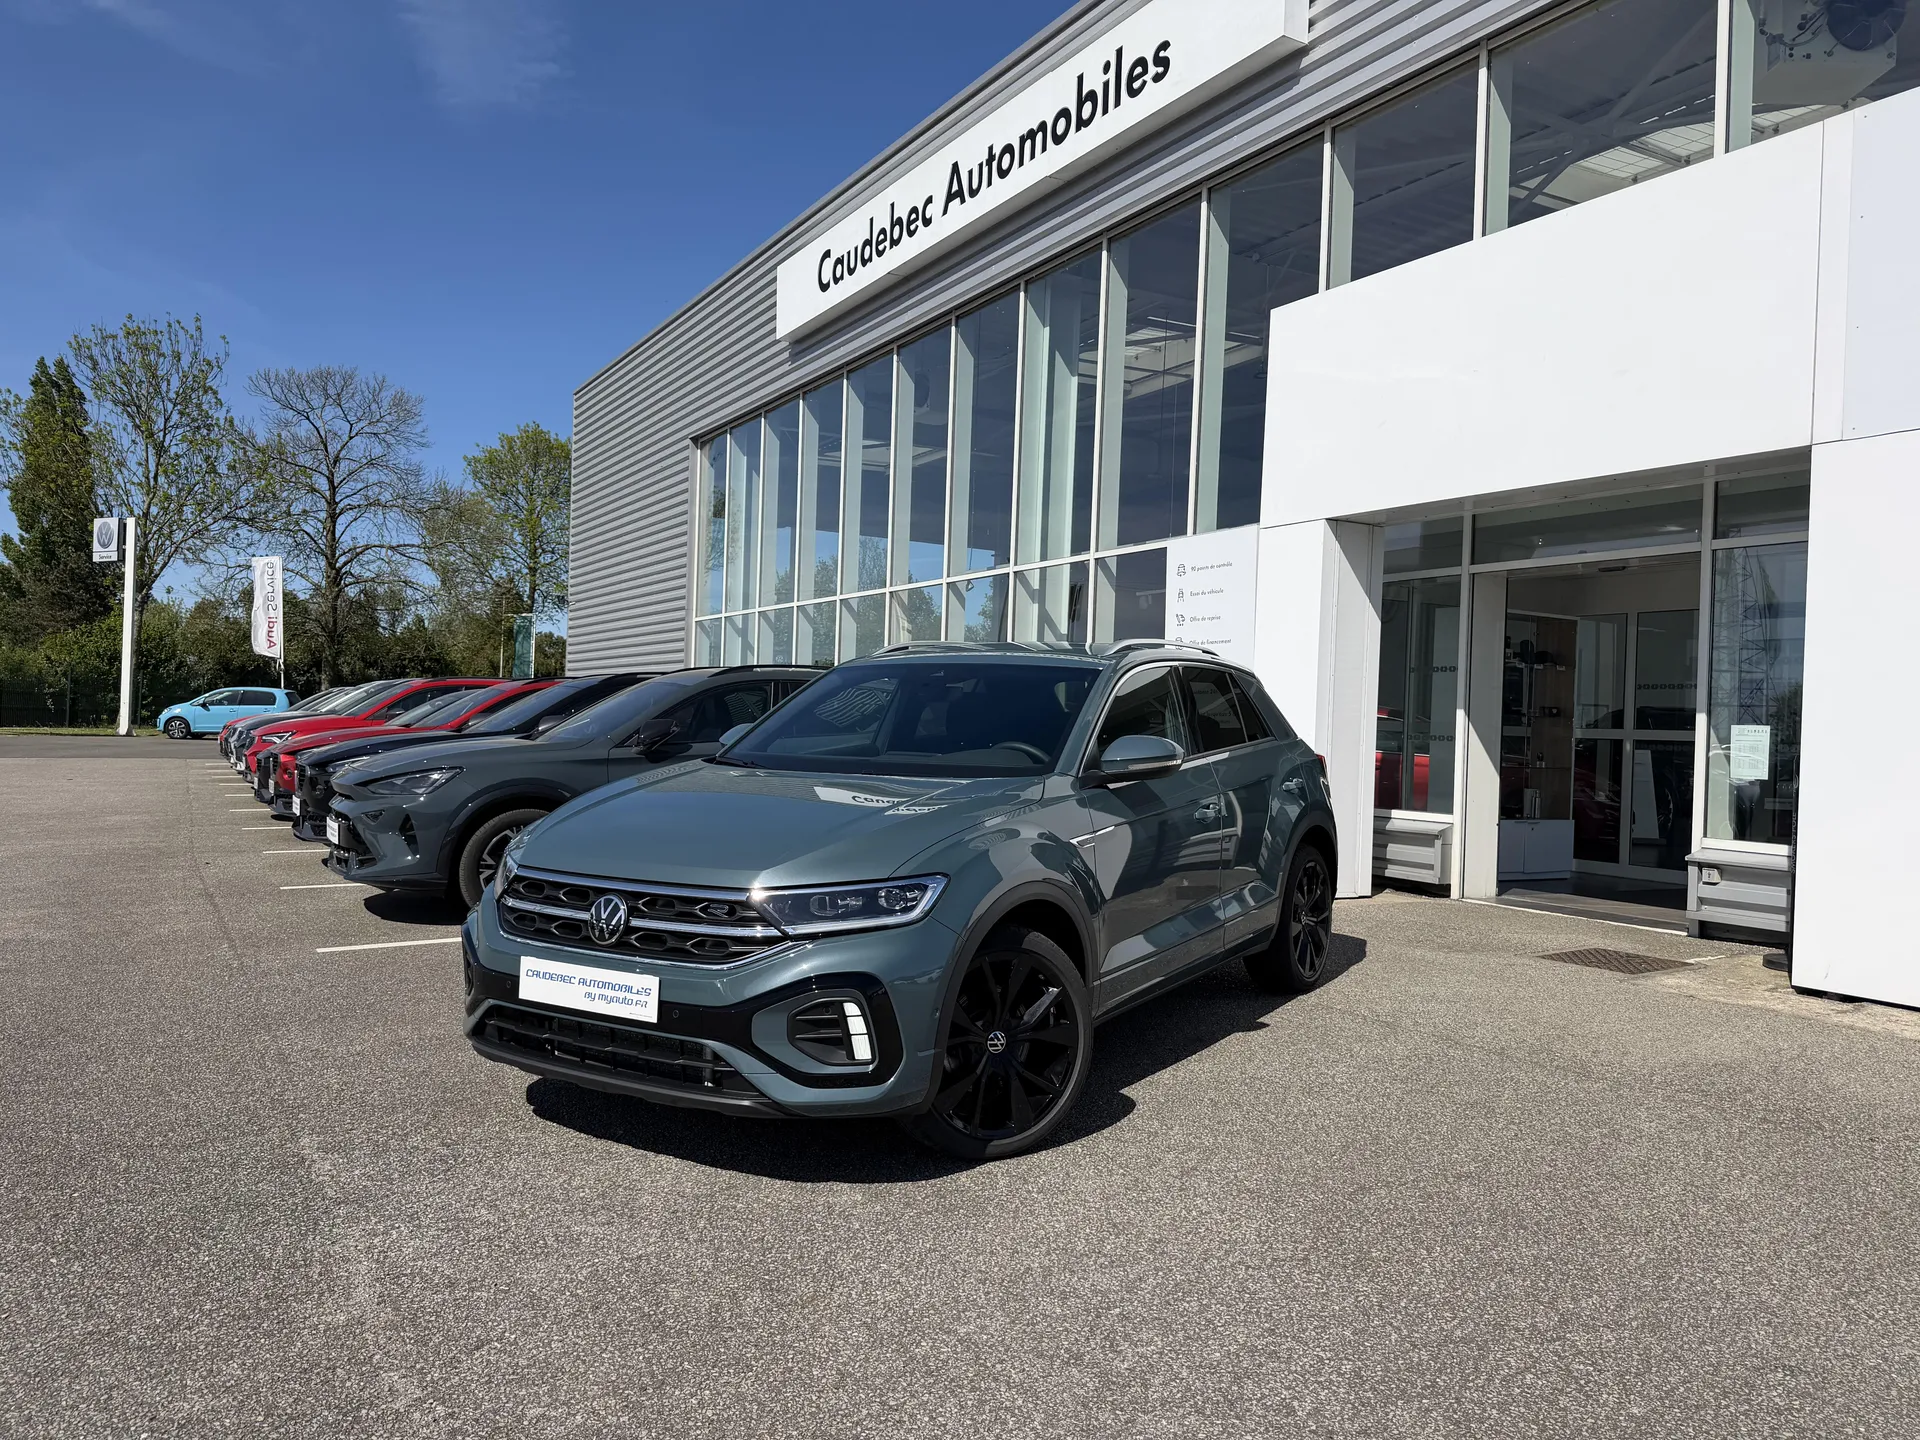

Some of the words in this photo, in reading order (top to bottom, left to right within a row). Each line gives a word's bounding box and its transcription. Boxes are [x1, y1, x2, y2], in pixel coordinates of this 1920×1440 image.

[817, 194, 934, 293] Caudebec
[941, 39, 1172, 217] Automobiles
[1207, 614, 1221, 622] reprise
[525, 968, 577, 985] CAUDEBEC
[577, 977, 652, 997] AUTOMOBILES
